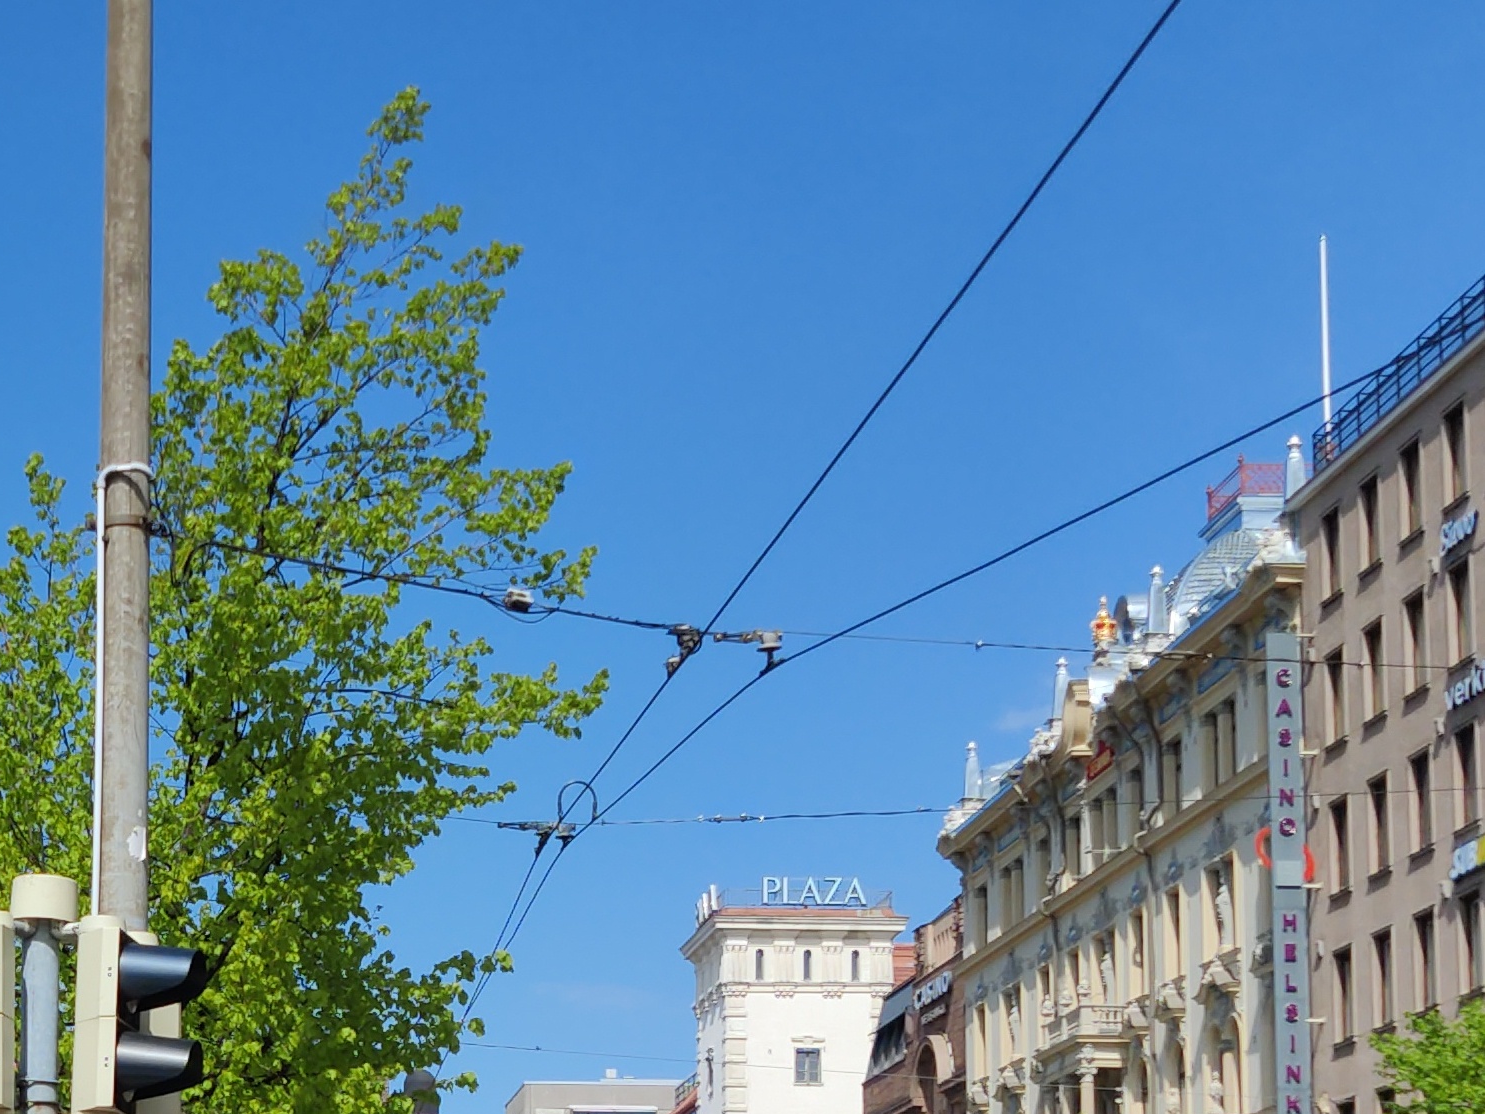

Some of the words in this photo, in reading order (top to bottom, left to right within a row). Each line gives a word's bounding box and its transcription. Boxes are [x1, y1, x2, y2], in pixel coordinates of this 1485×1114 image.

[1275, 667, 1298, 837] CASINO
[761, 876, 868, 906] PLAZA
[913, 970, 952, 1010] CASINO
